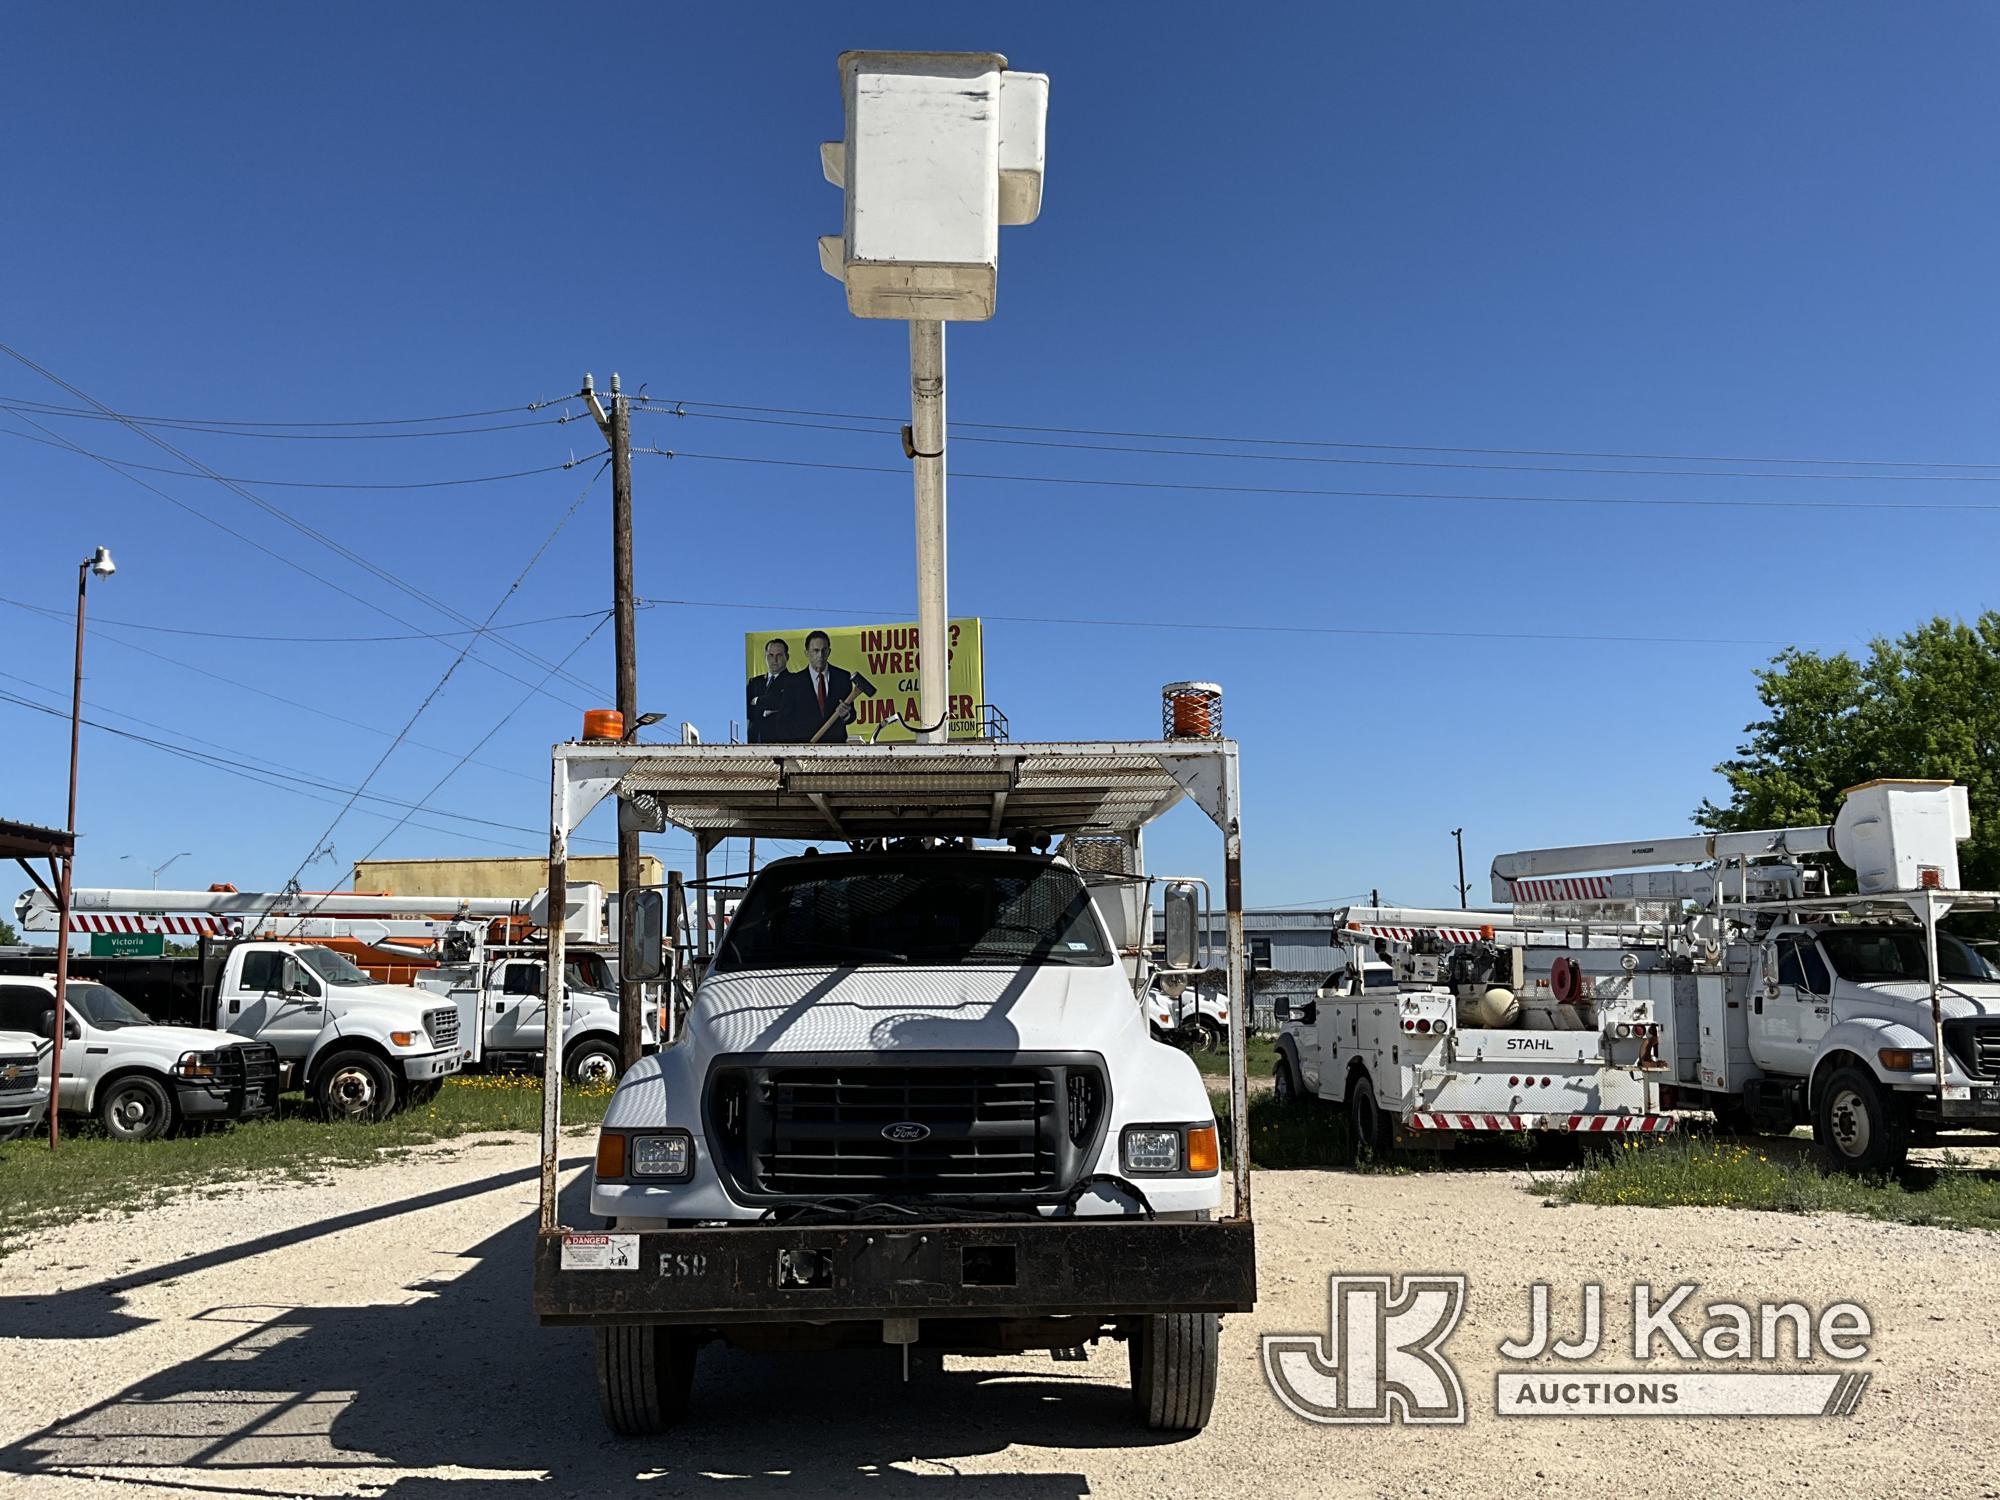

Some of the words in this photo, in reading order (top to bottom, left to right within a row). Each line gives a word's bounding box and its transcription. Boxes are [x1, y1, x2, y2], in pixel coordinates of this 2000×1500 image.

[861, 625, 961, 652] INJUR?
[898, 679, 920, 692] CAL
[857, 699, 897, 724] JIM
[904, 694, 975, 721] AER
[111, 938, 144, 946] Victoria
[1506, 1038, 1554, 1050] STAHL
[892, 1125, 920, 1138] Ford
